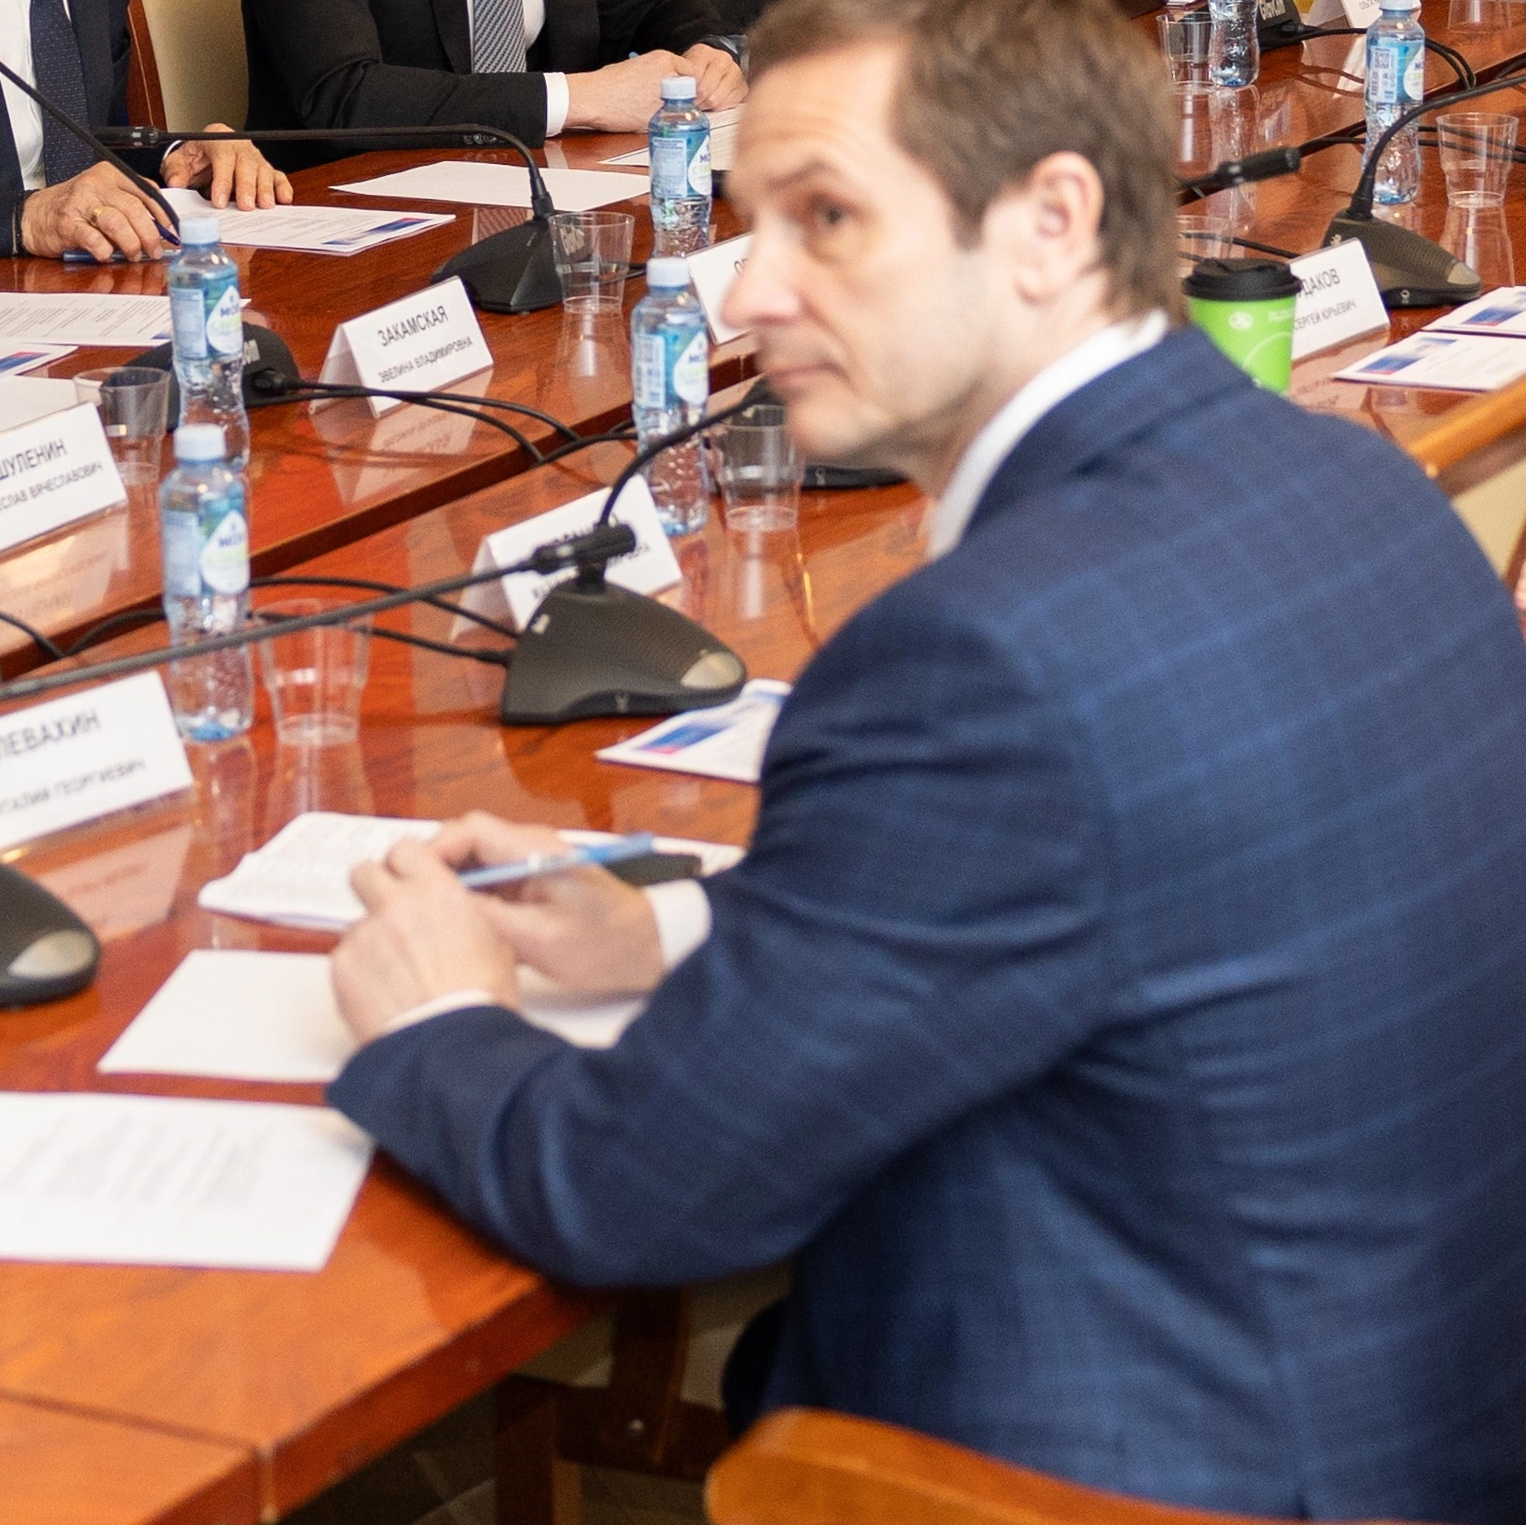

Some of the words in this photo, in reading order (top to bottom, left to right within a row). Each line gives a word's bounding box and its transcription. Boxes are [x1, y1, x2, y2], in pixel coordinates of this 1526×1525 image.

[1297, 268, 1341, 299] ДАКОВ
[377, 305, 449, 347] ЗАКАМСКАЯ
[378, 361, 416, 383] ЭВЕЛИНА
[415, 336, 474, 368] ВЛАДИМИРОВНА
[28, 460, 104, 499] ВЯЧЕСЛАВОВИЧ
